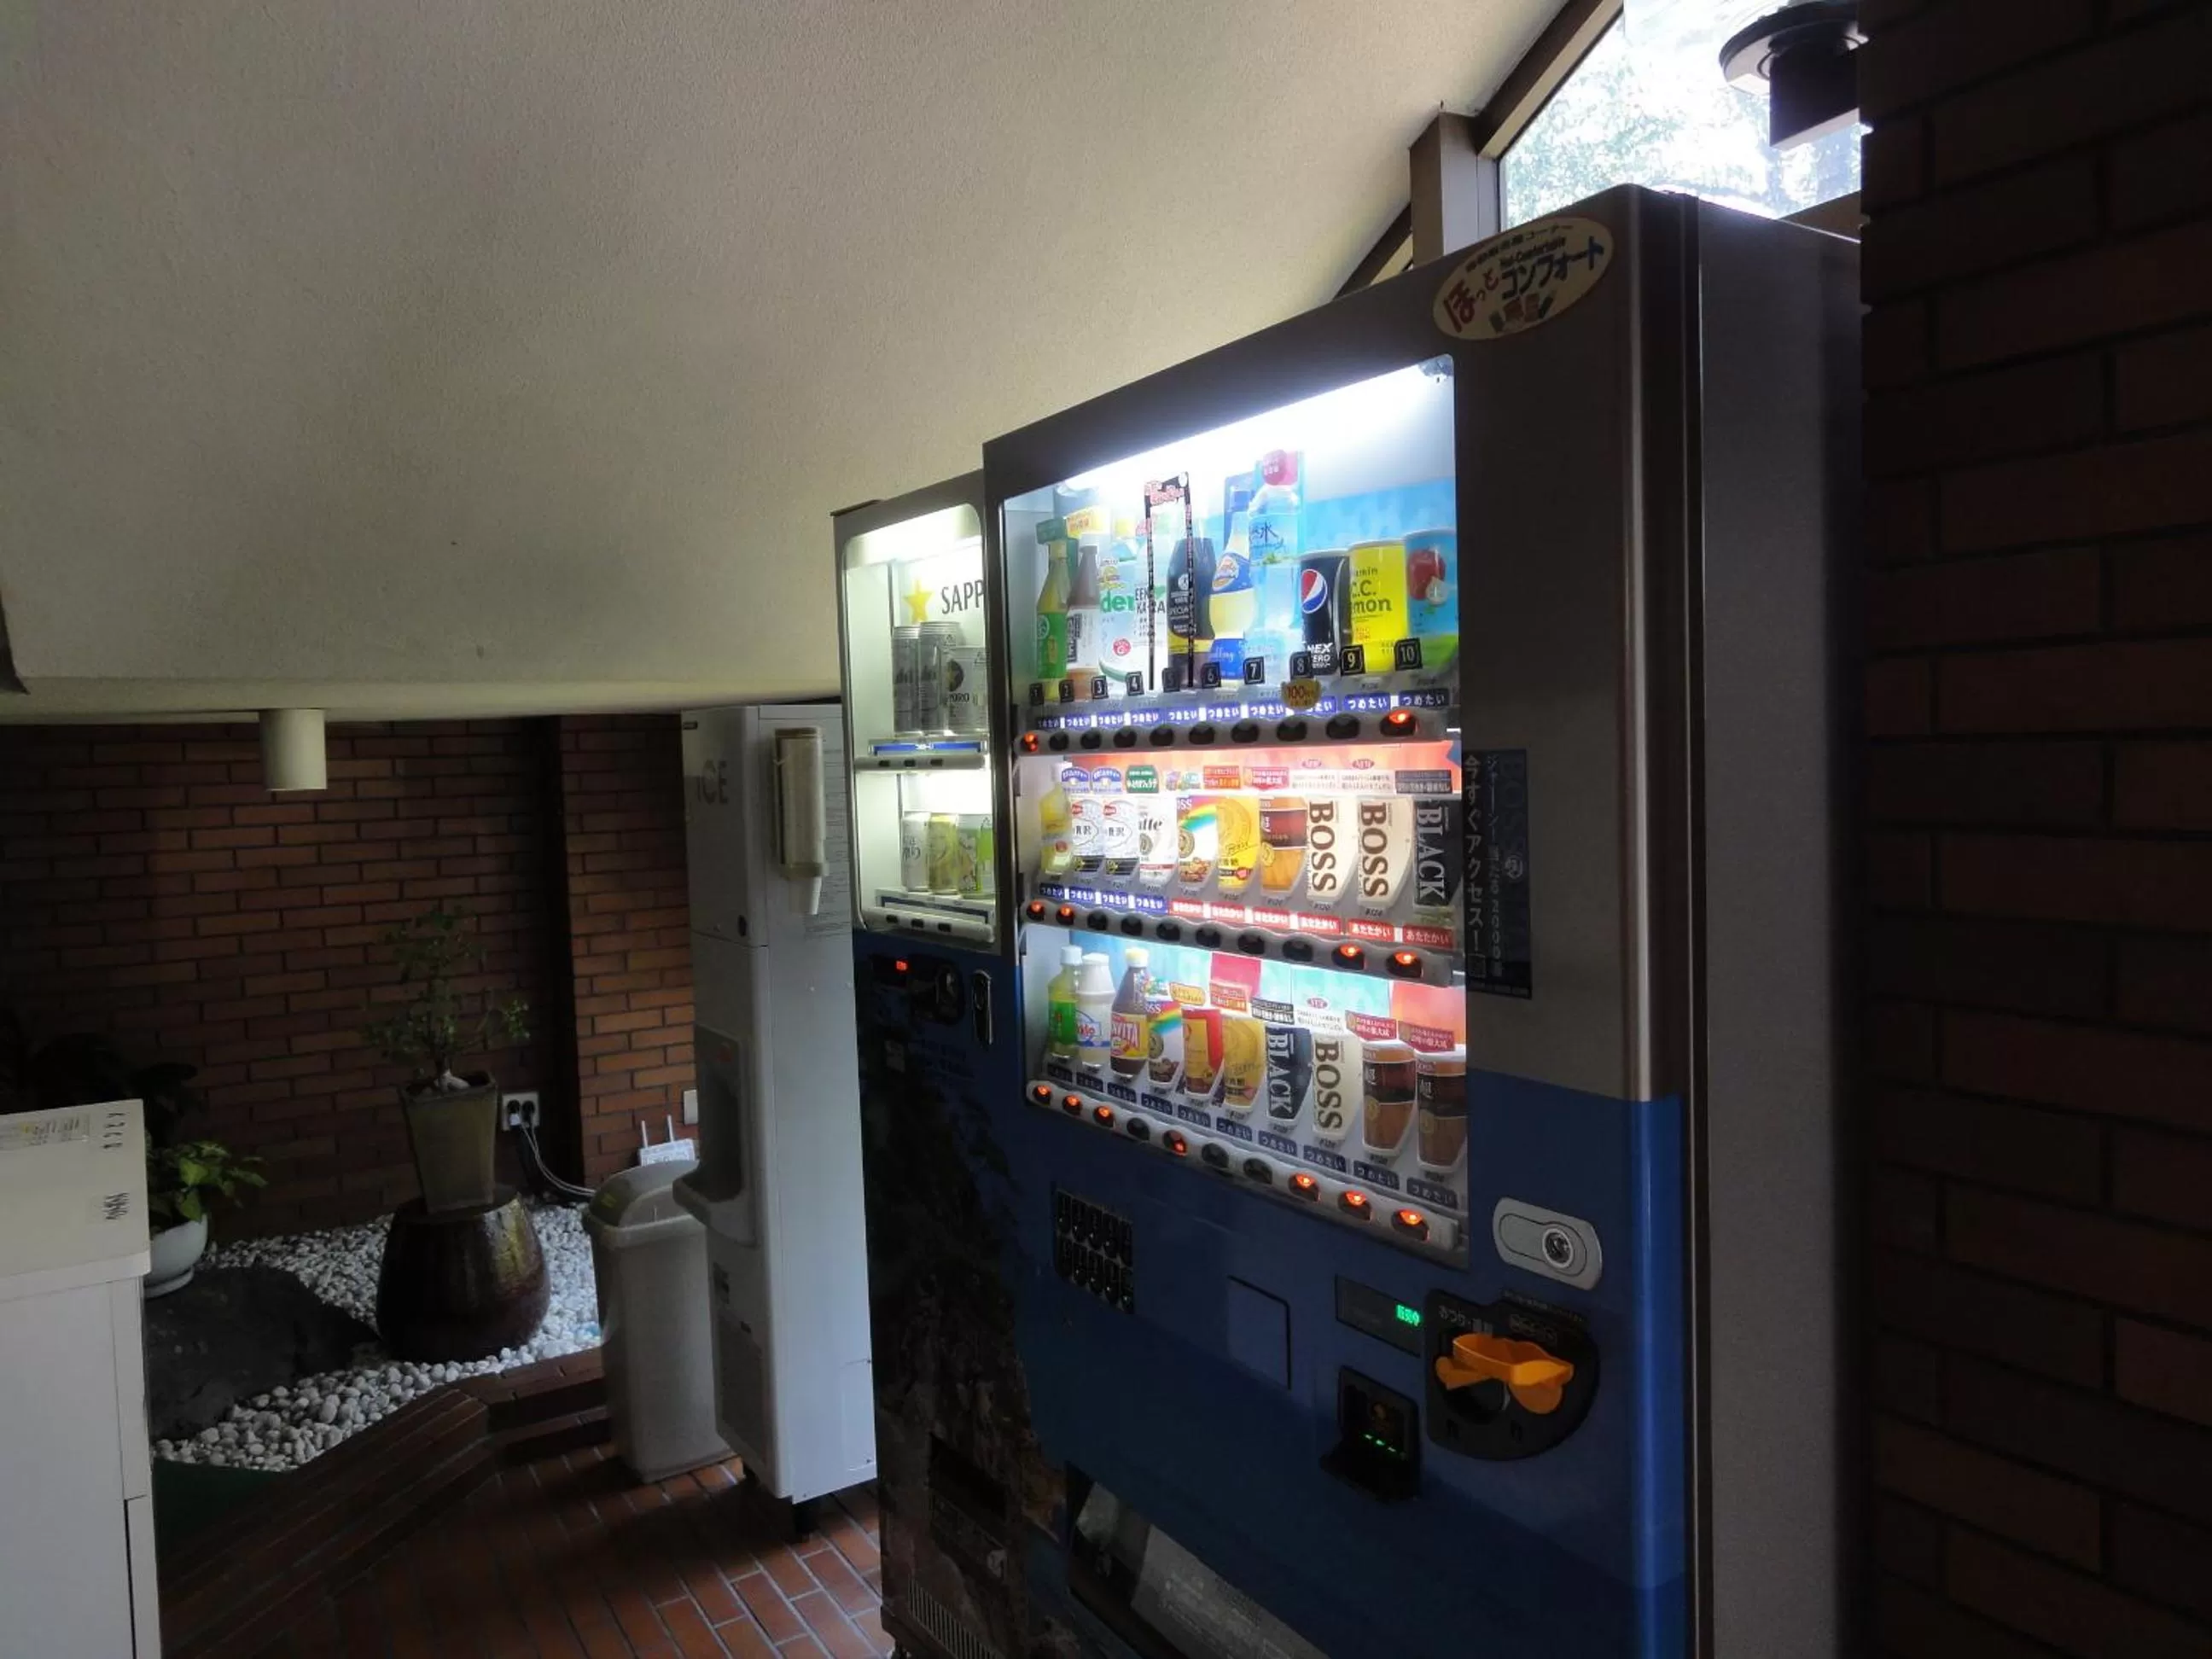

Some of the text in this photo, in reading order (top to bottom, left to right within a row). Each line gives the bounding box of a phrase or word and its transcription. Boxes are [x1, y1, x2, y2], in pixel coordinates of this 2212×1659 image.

[1297, 658, 1305, 673] 8
[1347, 653, 1355, 667] 9
[1400, 646, 1415, 663] 10
[1132, 675, 1138, 689] 4
[1250, 663, 1258, 678] 7
[1132, 712, 1159, 722] つめたい
[1168, 709, 1197, 721] つめたい
[1208, 707, 1238, 720] つめたい
[1251, 703, 1284, 715] つめたい
[1348, 698, 1387, 711] つめたい
[1402, 694, 1445, 707] つめたい
[696, 760, 728, 805] ICE
[1309, 800, 1337, 893] BOSS
[1360, 801, 1389, 898] BOSS
[1418, 806, 1445, 899] BLACK
[1136, 897, 1163, 910] つめたい
[1352, 923, 1392, 937] あたたかい
[1406, 930, 1450, 945] あたたかい
[1267, 1033, 1292, 1114] BLACK
[1315, 1040, 1342, 1129] BOSS
[1307, 1150, 1344, 1171] つめたい
[1357, 1166, 1395, 1188] つめたい
[1412, 1184, 1452, 1206] つめたい
